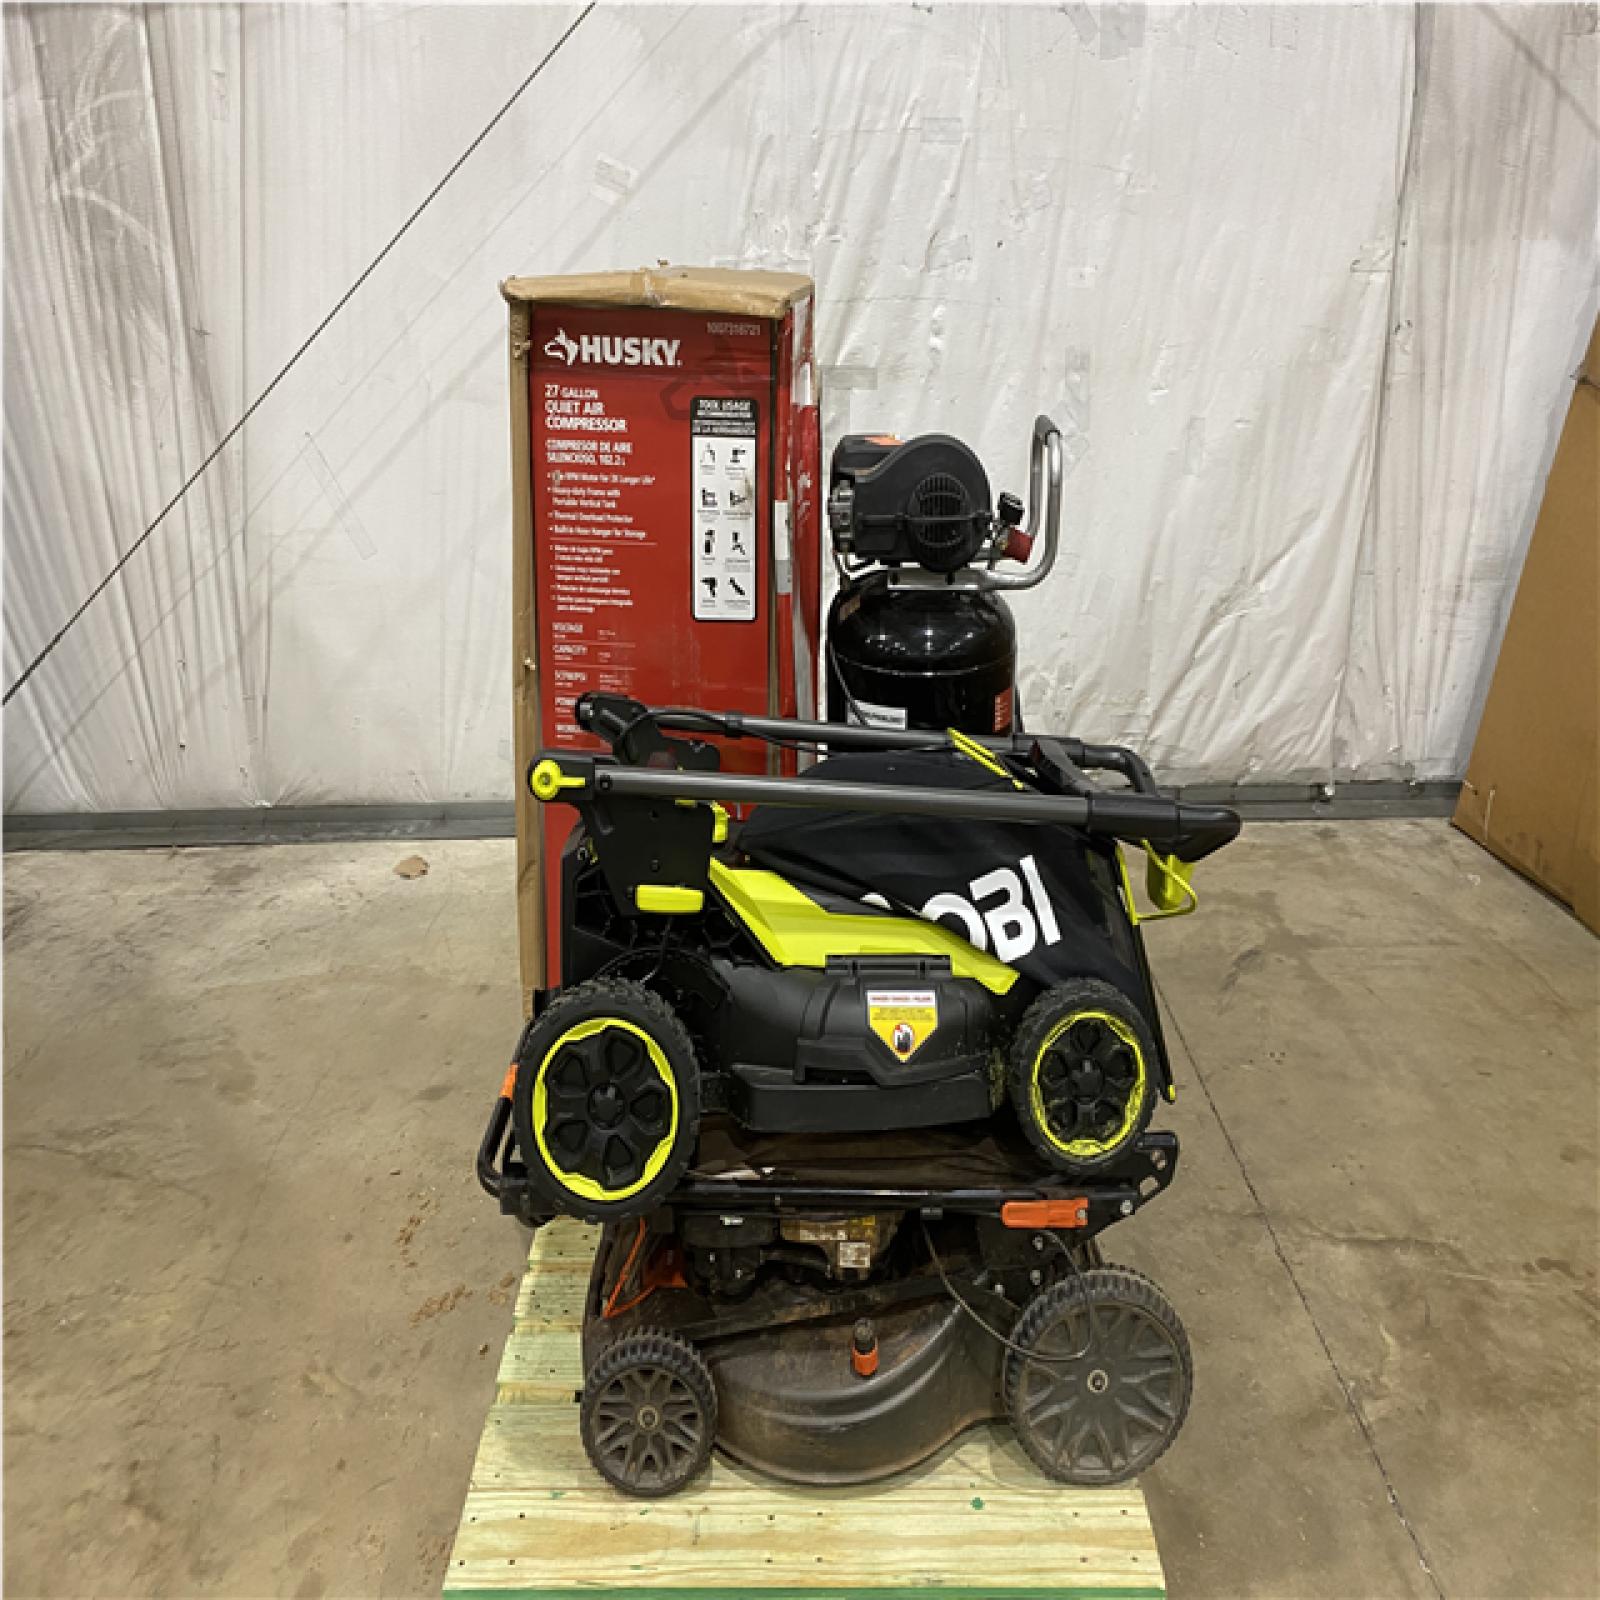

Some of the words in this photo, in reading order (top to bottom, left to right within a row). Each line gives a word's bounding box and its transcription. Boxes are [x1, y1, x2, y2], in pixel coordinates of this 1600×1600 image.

[580, 336, 681, 365] HUSKY
[561, 387, 599, 399] GALLON
[545, 400, 580, 415] QUIET
[583, 402, 605, 415] AIR
[545, 416, 627, 432] COMPRESSOR
